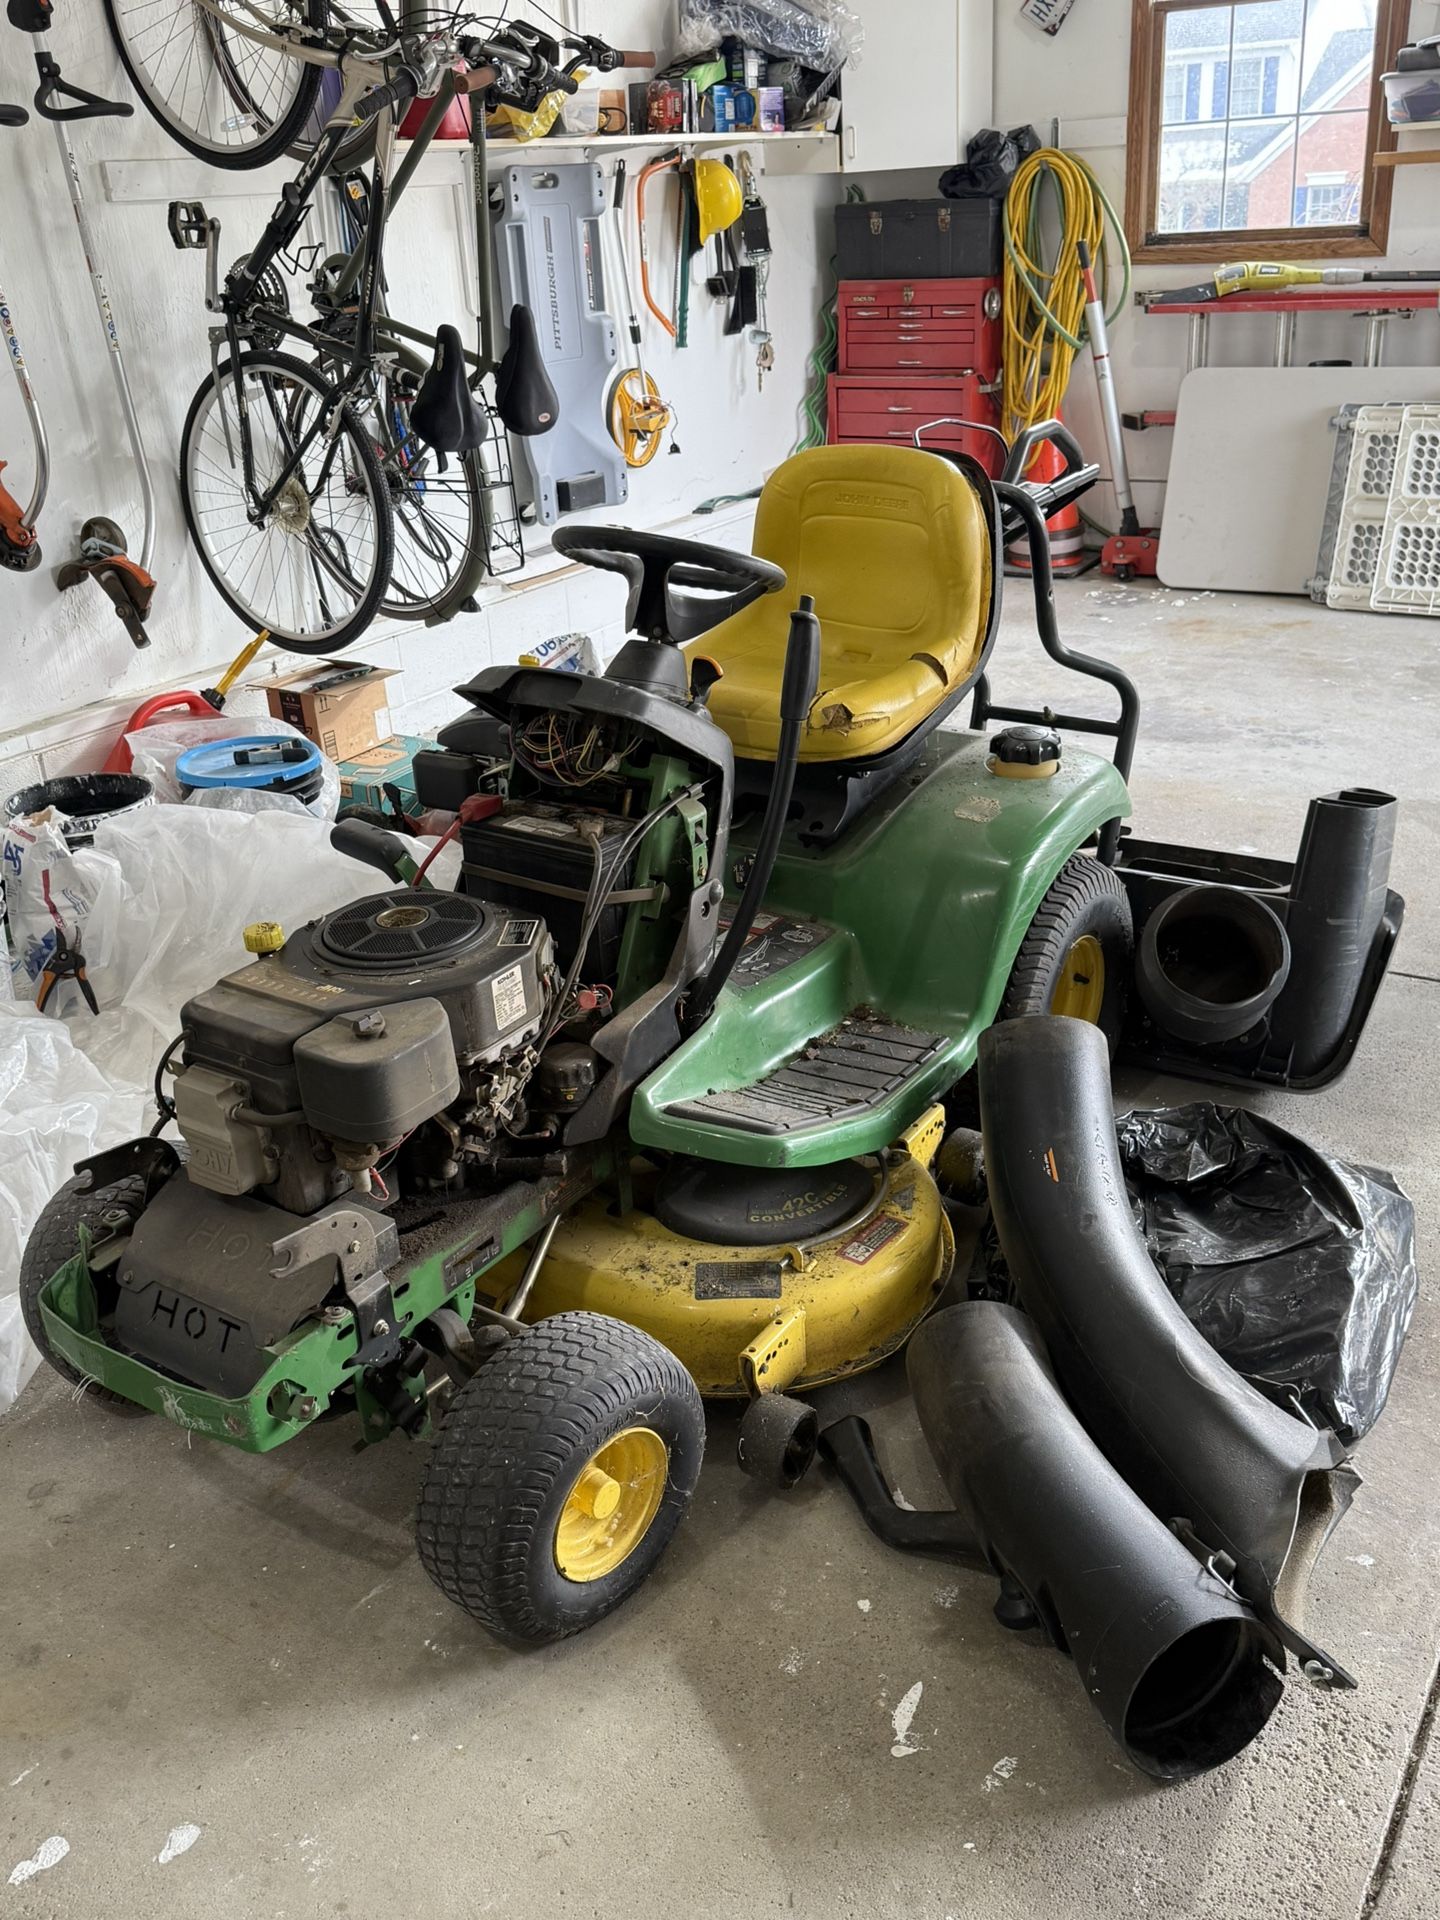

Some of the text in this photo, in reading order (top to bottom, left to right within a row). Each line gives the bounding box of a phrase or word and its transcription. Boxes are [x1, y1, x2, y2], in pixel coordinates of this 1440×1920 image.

[1030, 0, 1058, 23] HX
[546, 255, 562, 351] PITTSBURGH
[834, 492, 910, 511] JOHN DEERE
[535, 639, 557, 657] 90
[4, 840, 25, 876] 45
[497, 971, 515, 985] KOHLER
[750, 1184, 848, 1222] CONVERTIBLE
[782, 1192, 819, 1212] 42C
[153, 1289, 241, 1353] HOT
